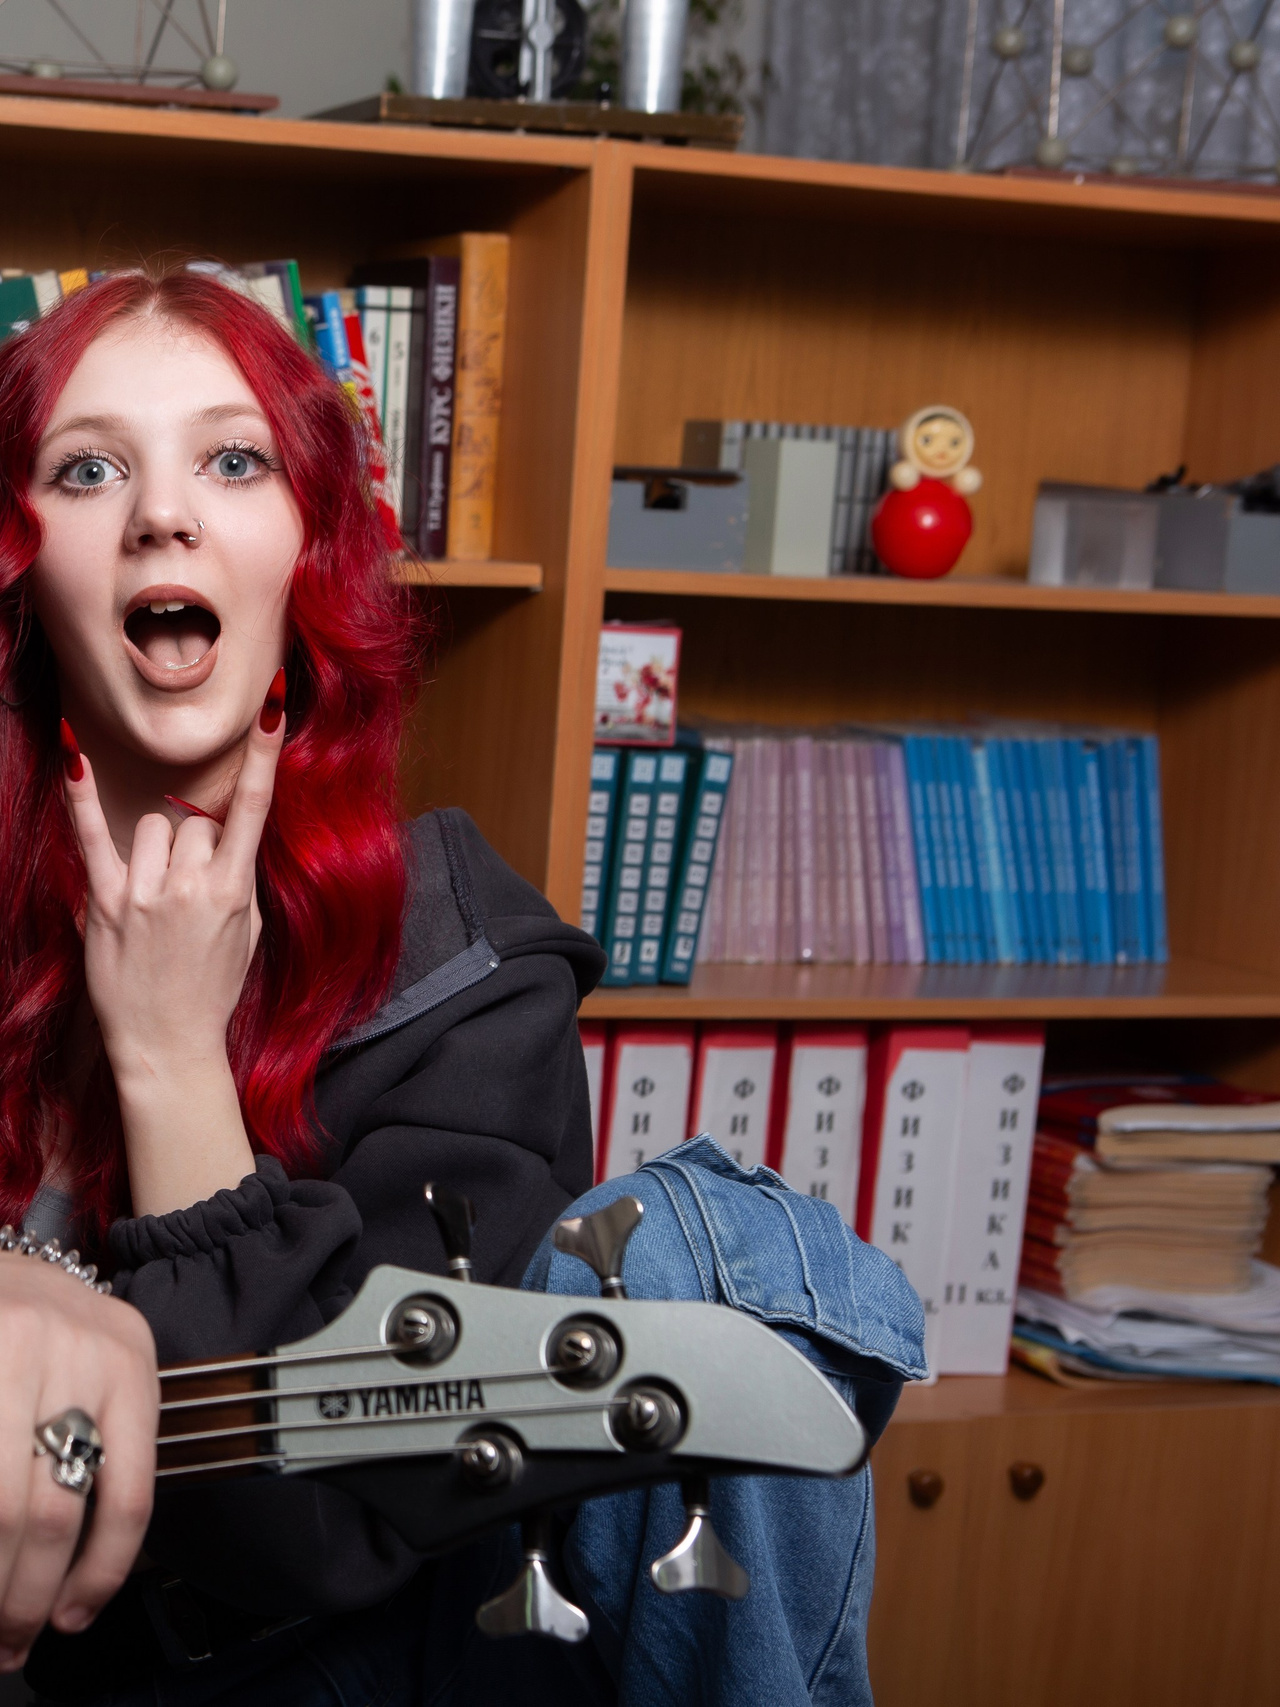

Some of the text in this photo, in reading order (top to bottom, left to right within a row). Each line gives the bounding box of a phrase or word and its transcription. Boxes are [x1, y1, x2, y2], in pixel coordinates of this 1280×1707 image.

[431, 284, 457, 382] ФИЗИКИ
[428, 386, 453, 445] КУРС
[631, 1076, 655, 1168] ФИЗ
[729, 1078, 756, 1172] ФИЗ
[809, 1076, 841, 1200] ФИЗИ
[983, 1073, 1026, 1271] ФИЗИКА
[358, 1379, 487, 1417] YAMAHA
